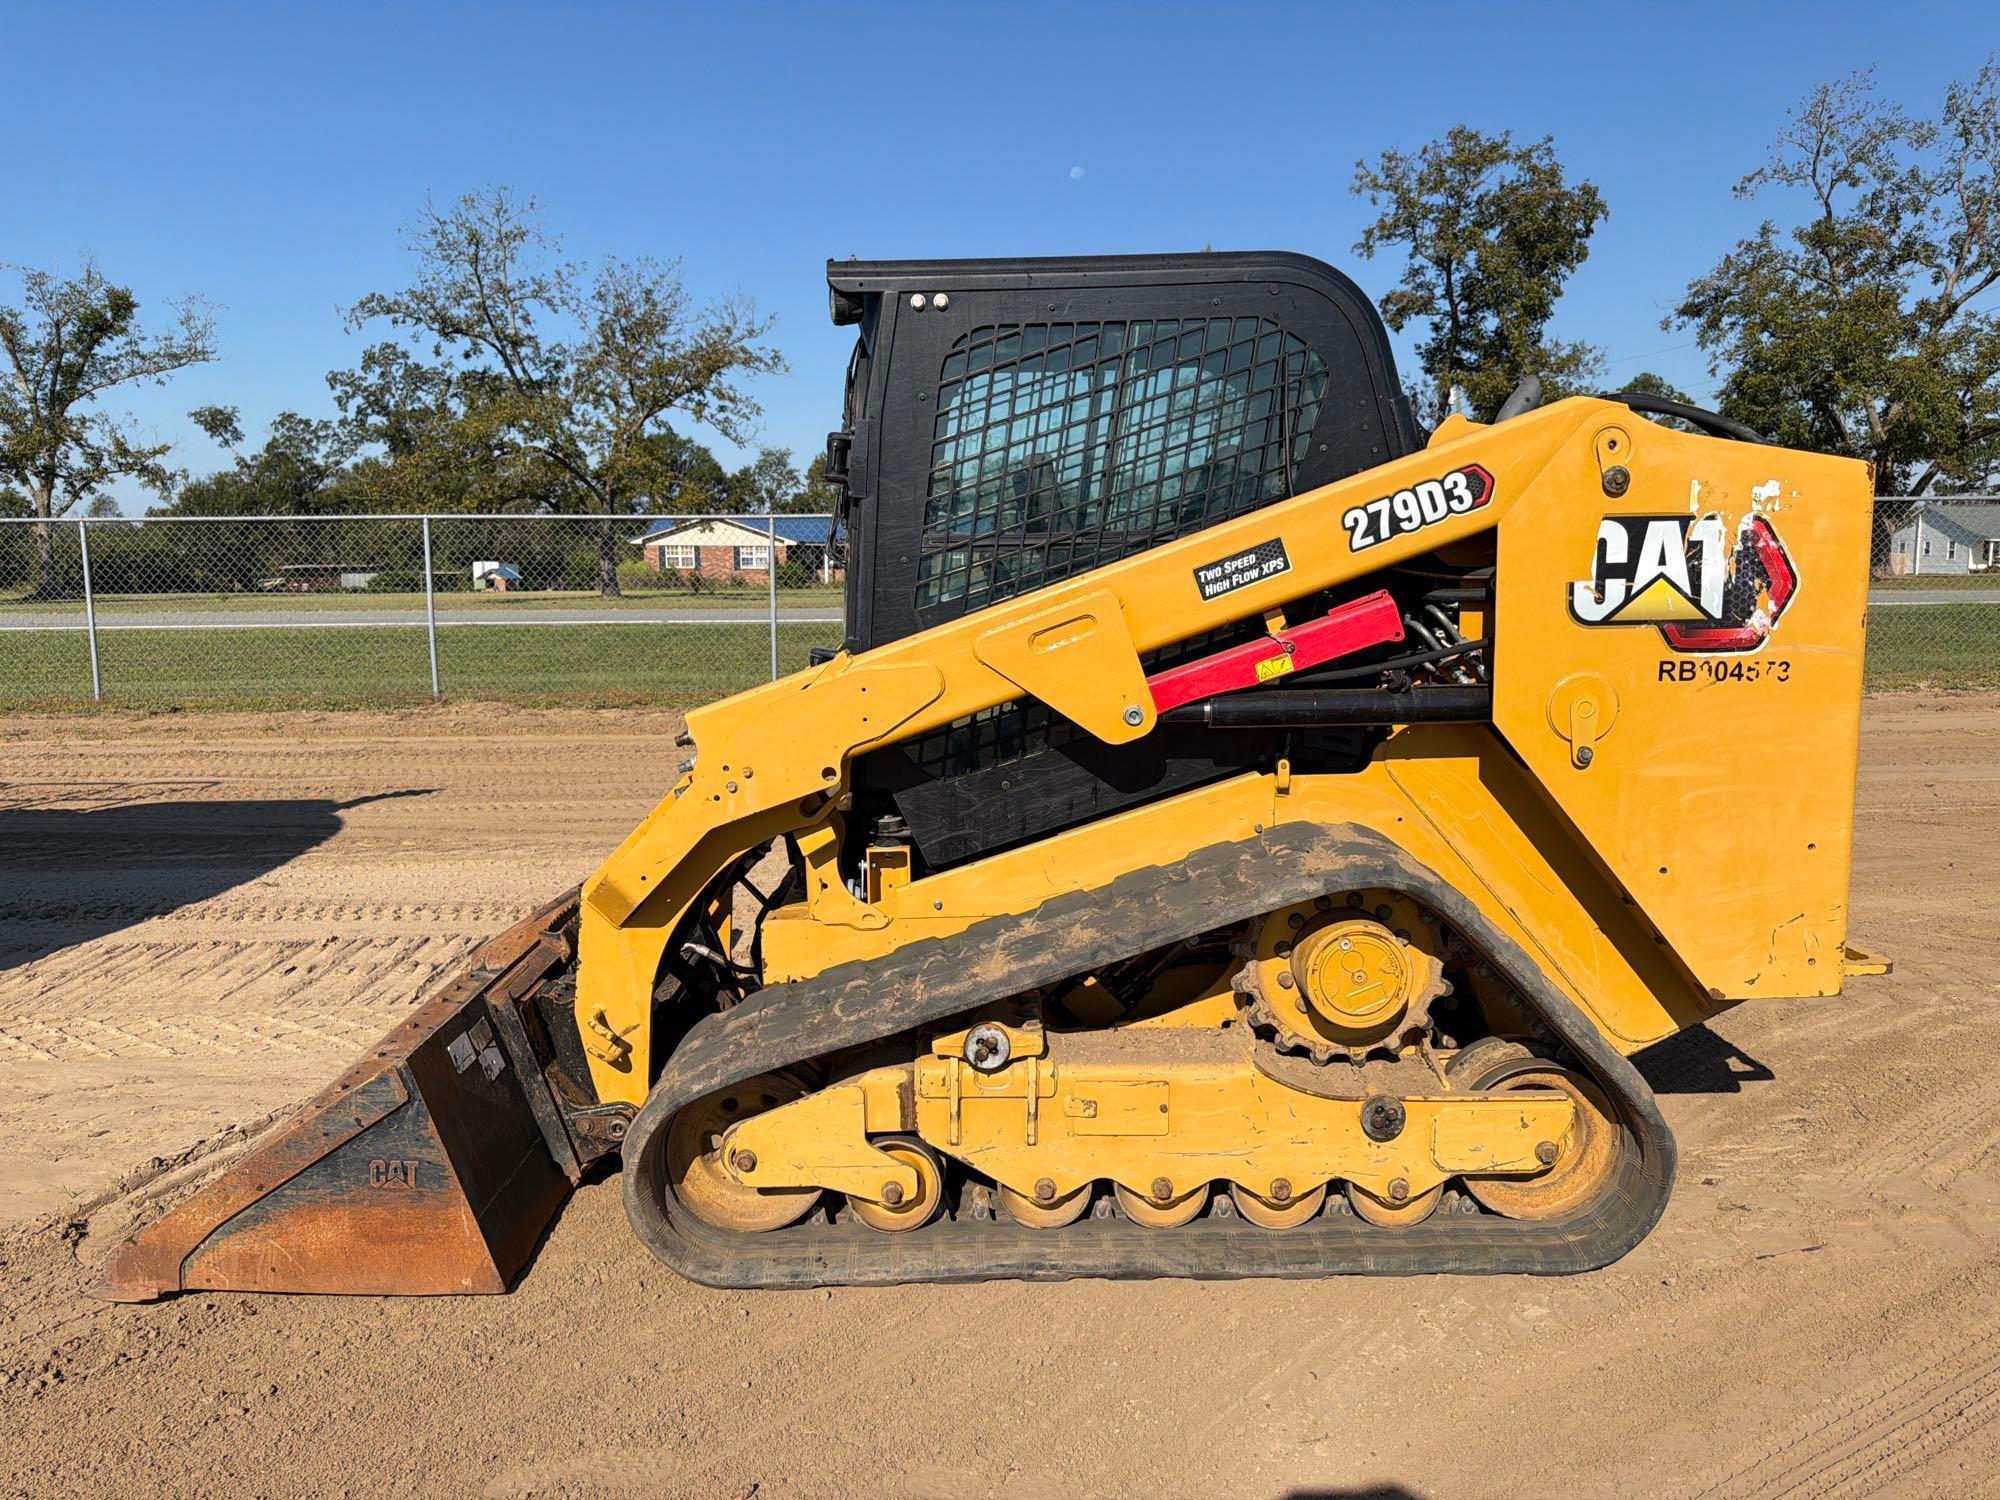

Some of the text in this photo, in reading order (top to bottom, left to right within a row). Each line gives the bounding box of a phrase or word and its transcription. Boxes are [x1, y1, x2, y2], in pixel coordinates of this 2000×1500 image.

[1343, 472, 1473, 550] 279D3
[1199, 554, 1256, 583] TWO SPEED
[1204, 557, 1284, 597] HIGH FLOW XPS
[1573, 518, 1726, 621] CAT
[368, 1159, 420, 1189] CAT
